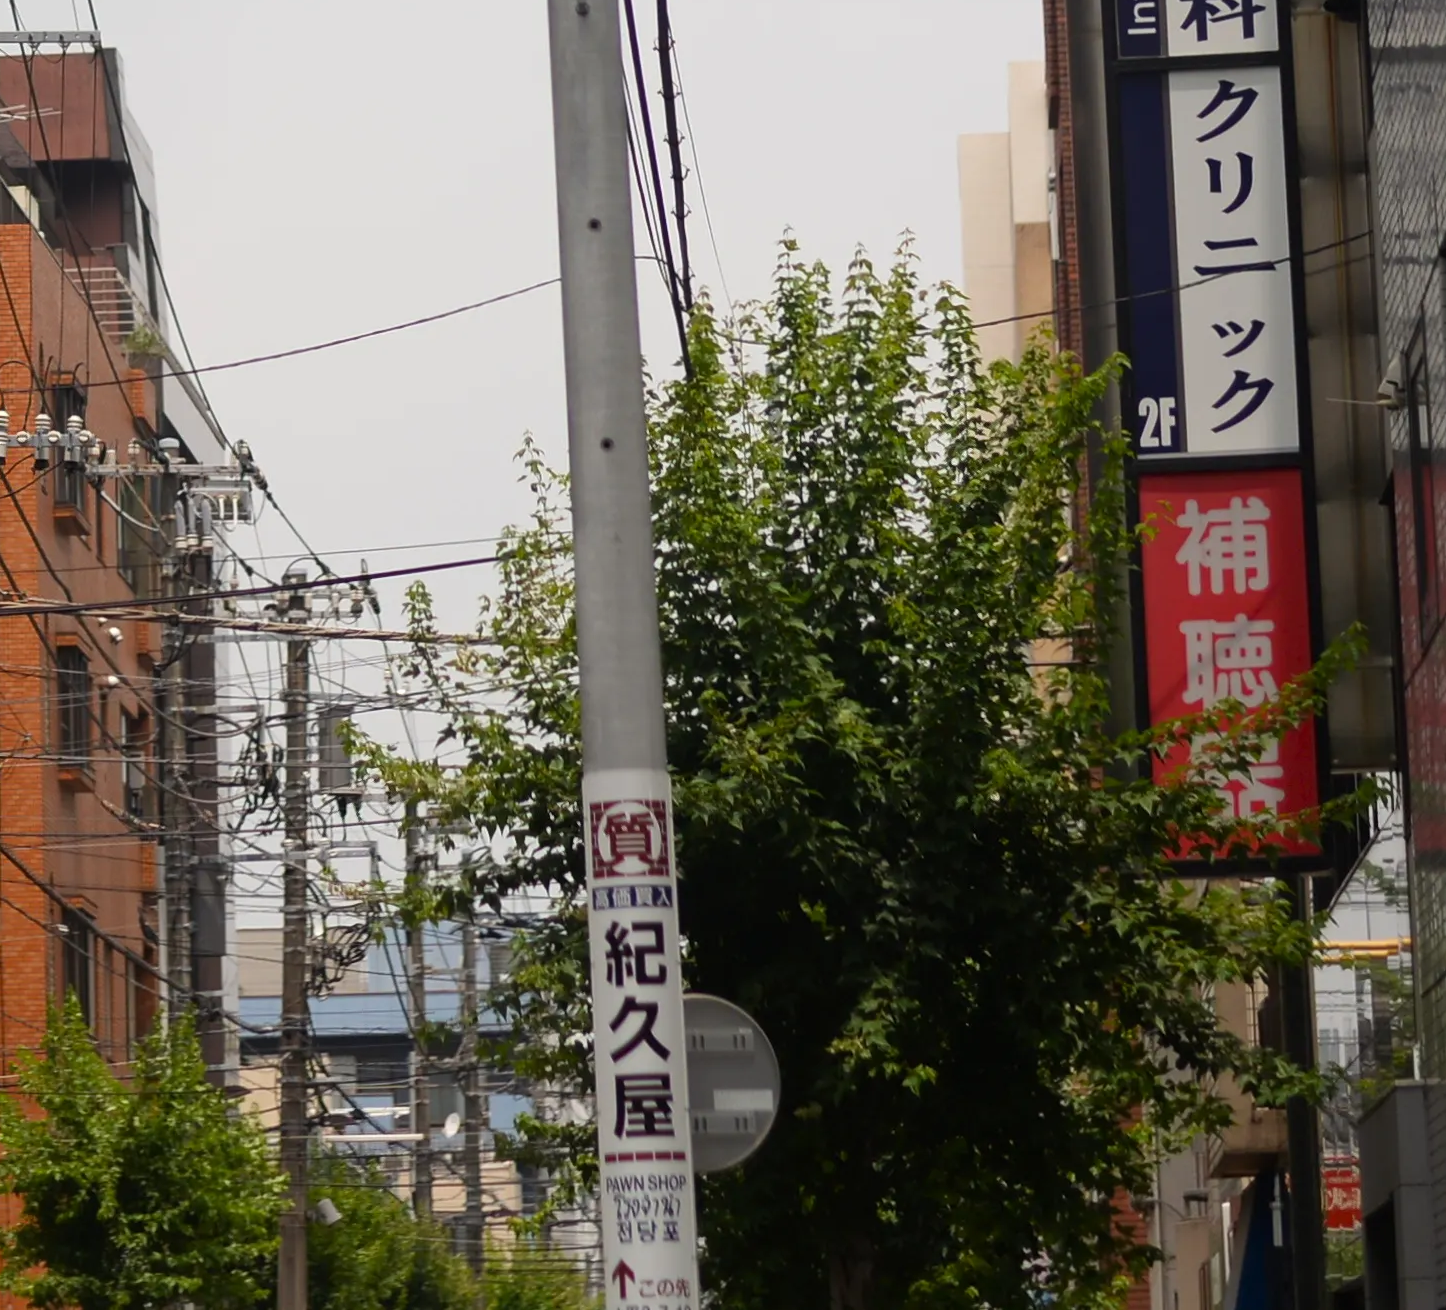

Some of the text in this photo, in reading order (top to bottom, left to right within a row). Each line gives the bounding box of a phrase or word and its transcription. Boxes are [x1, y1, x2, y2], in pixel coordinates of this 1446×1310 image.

[1193, 79, 1277, 434] クリニック
[1137, 396, 1177, 448] 2F
[604, 919, 677, 1142] 紀久屋
[606, 1174, 687, 1194] PAWN SHOP
[638, 1278, 691, 1298] この先
